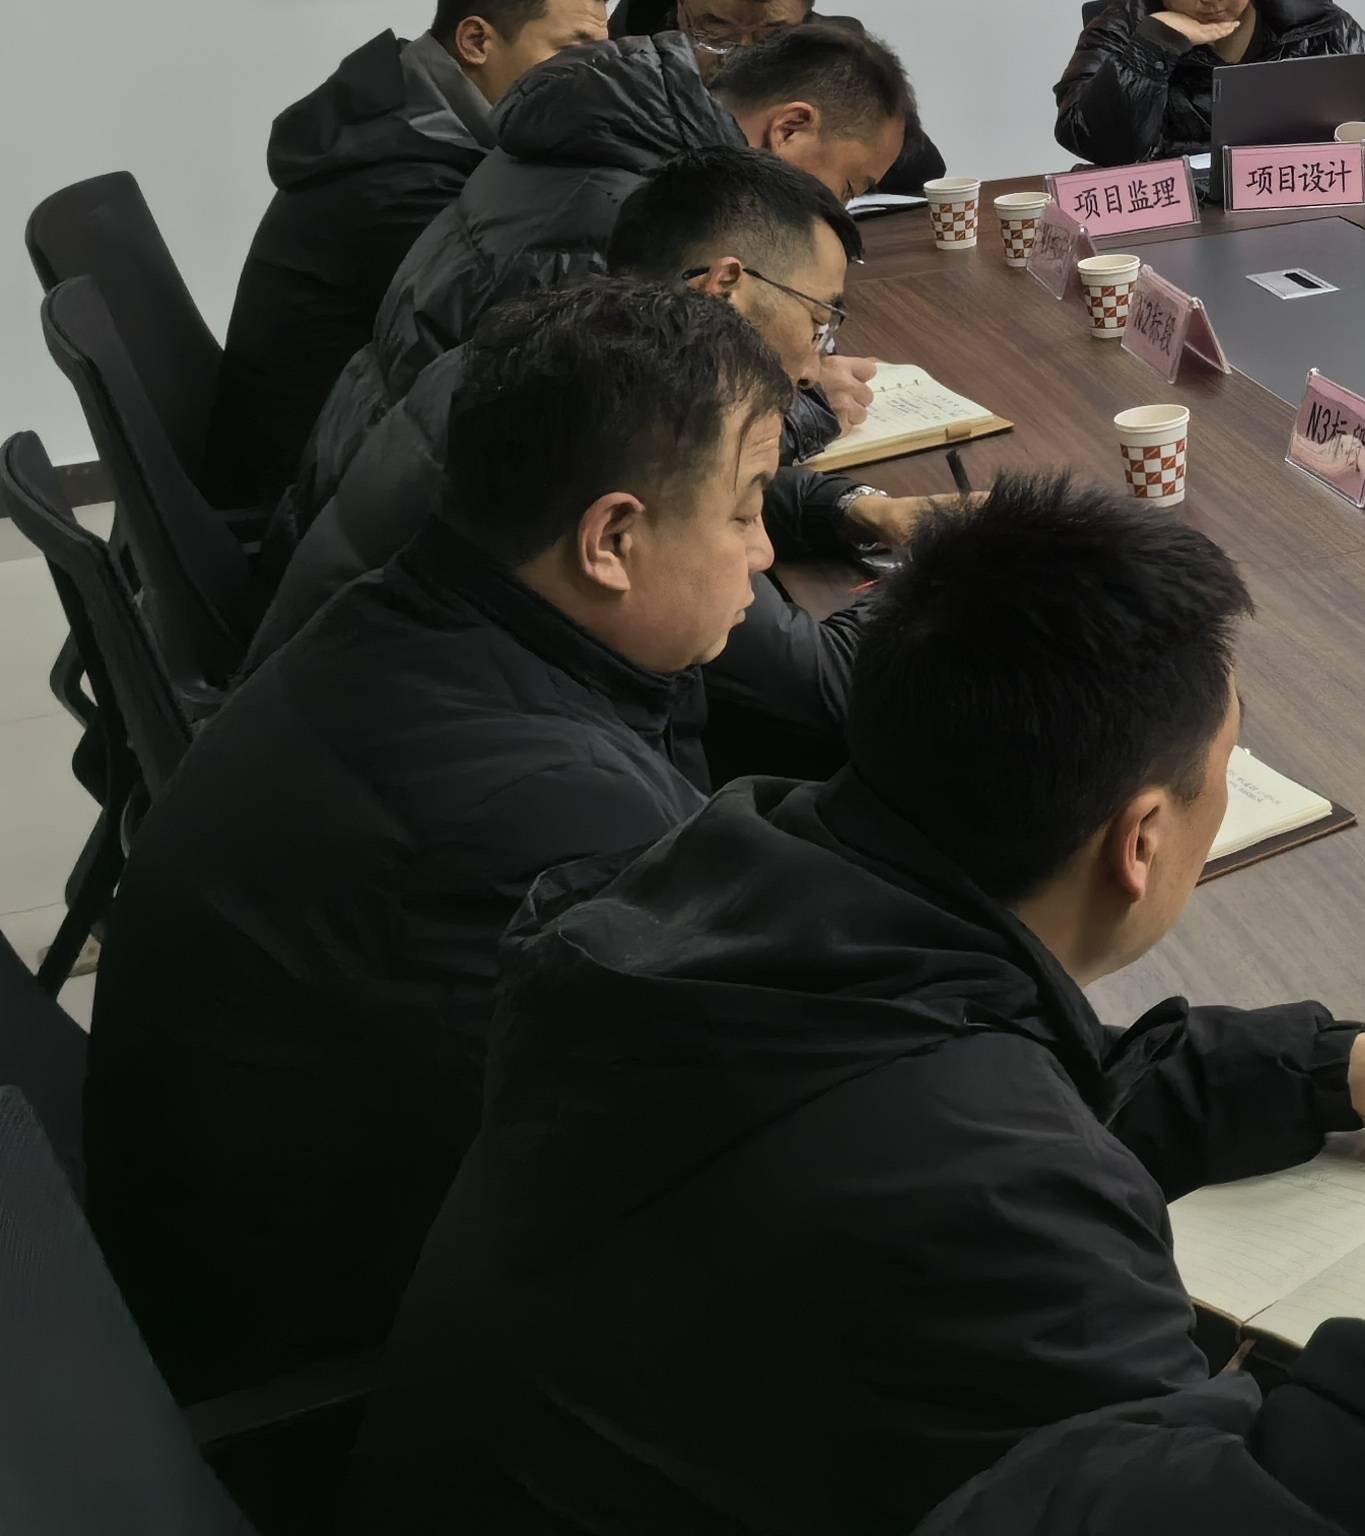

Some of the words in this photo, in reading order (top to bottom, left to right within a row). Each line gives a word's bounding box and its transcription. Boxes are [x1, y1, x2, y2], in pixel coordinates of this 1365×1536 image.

[1073, 175, 1182, 221] 项目监理
[1245, 159, 1354, 196] 项目设计
[1133, 294, 1177, 356] N2标段
